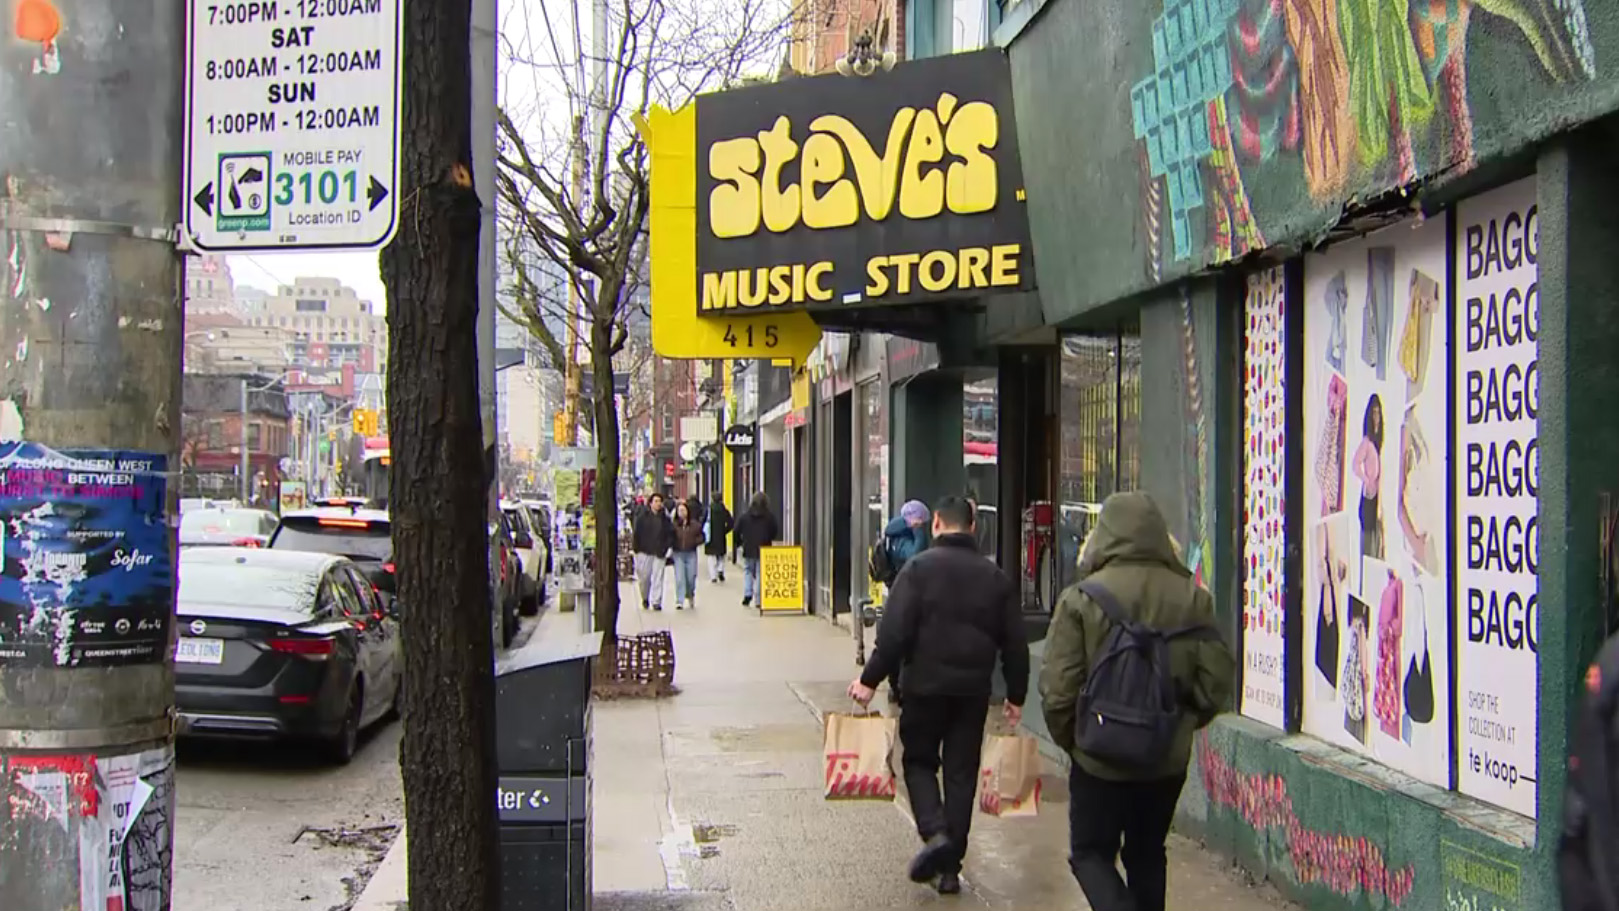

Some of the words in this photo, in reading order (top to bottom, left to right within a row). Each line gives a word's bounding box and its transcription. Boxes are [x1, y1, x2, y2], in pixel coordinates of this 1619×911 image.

[208, 2, 277, 25] 7:00PM
[297, 0, 381, 19] 12:00AM
[271, 27, 315, 48] SAT
[206, 57, 277, 80] 8:00AM
[297, 49, 381, 74] 12:00AM
[267, 82, 315, 103] SUN
[207, 112, 275, 134] 1:00PM
[295, 106, 380, 130] 12:00AM
[284, 152, 333, 166] MOBILE
[338, 150, 362, 164] PAY
[274, 170, 357, 205] 3101
[289, 211, 342, 225] Location
[347, 210, 361, 224] ID
[701, 261, 834, 310] MUSIC
[865, 244, 1020, 297] STORE
[722, 325, 778, 348] 415
[68, 458, 115, 471] QUEEN
[118, 460, 153, 471] WEST
[68, 473, 134, 485] BETWEEN
[66, 530, 114, 538] SUPPORTED
[110, 549, 153, 571] Sofar
[765, 571, 797, 580] YOUR
[765, 589, 799, 599] FACE
[1469, 691, 1486, 711] SHOP
[1487, 694, 1499, 715] THE
[1468, 717, 1506, 742] COLLECTION
[1507, 726, 1516, 745] AT
[1469, 747, 1481, 773] te
[1484, 751, 1518, 789] koop
